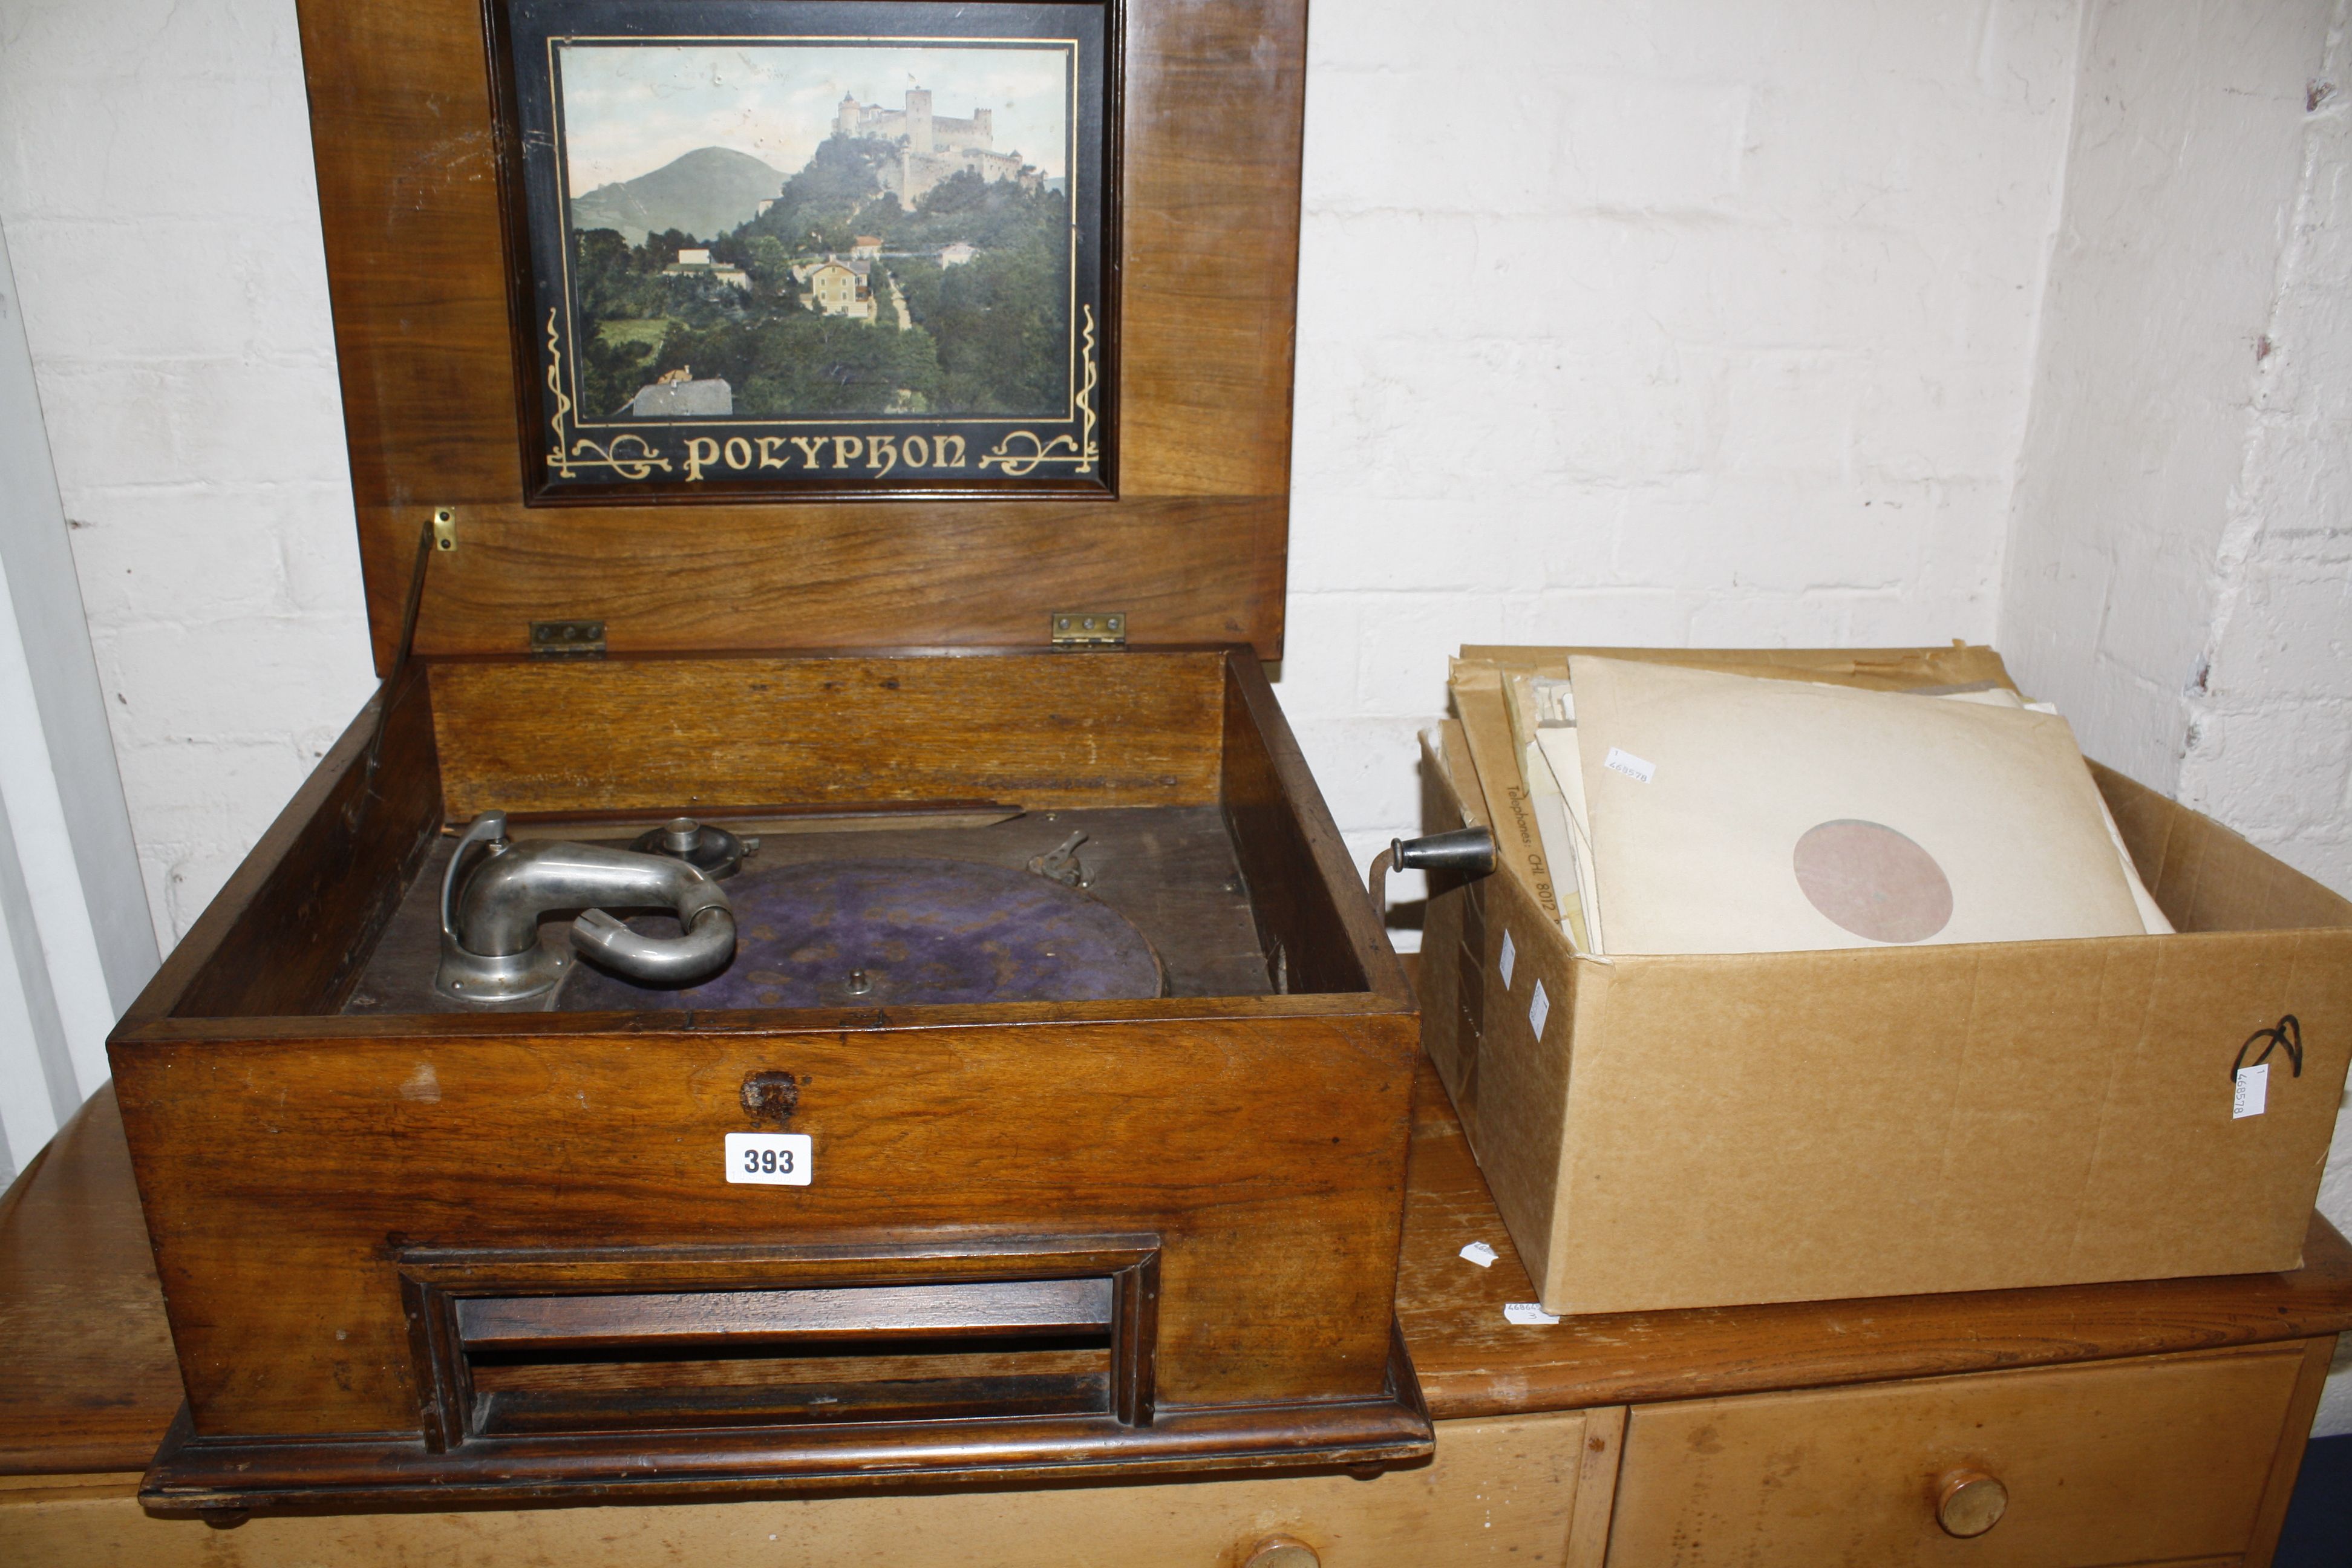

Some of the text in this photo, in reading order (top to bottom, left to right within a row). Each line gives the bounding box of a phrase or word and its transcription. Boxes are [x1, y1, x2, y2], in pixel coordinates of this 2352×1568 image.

[683, 435, 966, 482] POLYPHON
[1507, 785, 1556, 911] Telephones: CHL 8012
[2233, 1073, 2247, 1114] 468578
[744, 1149, 794, 1174] 393
